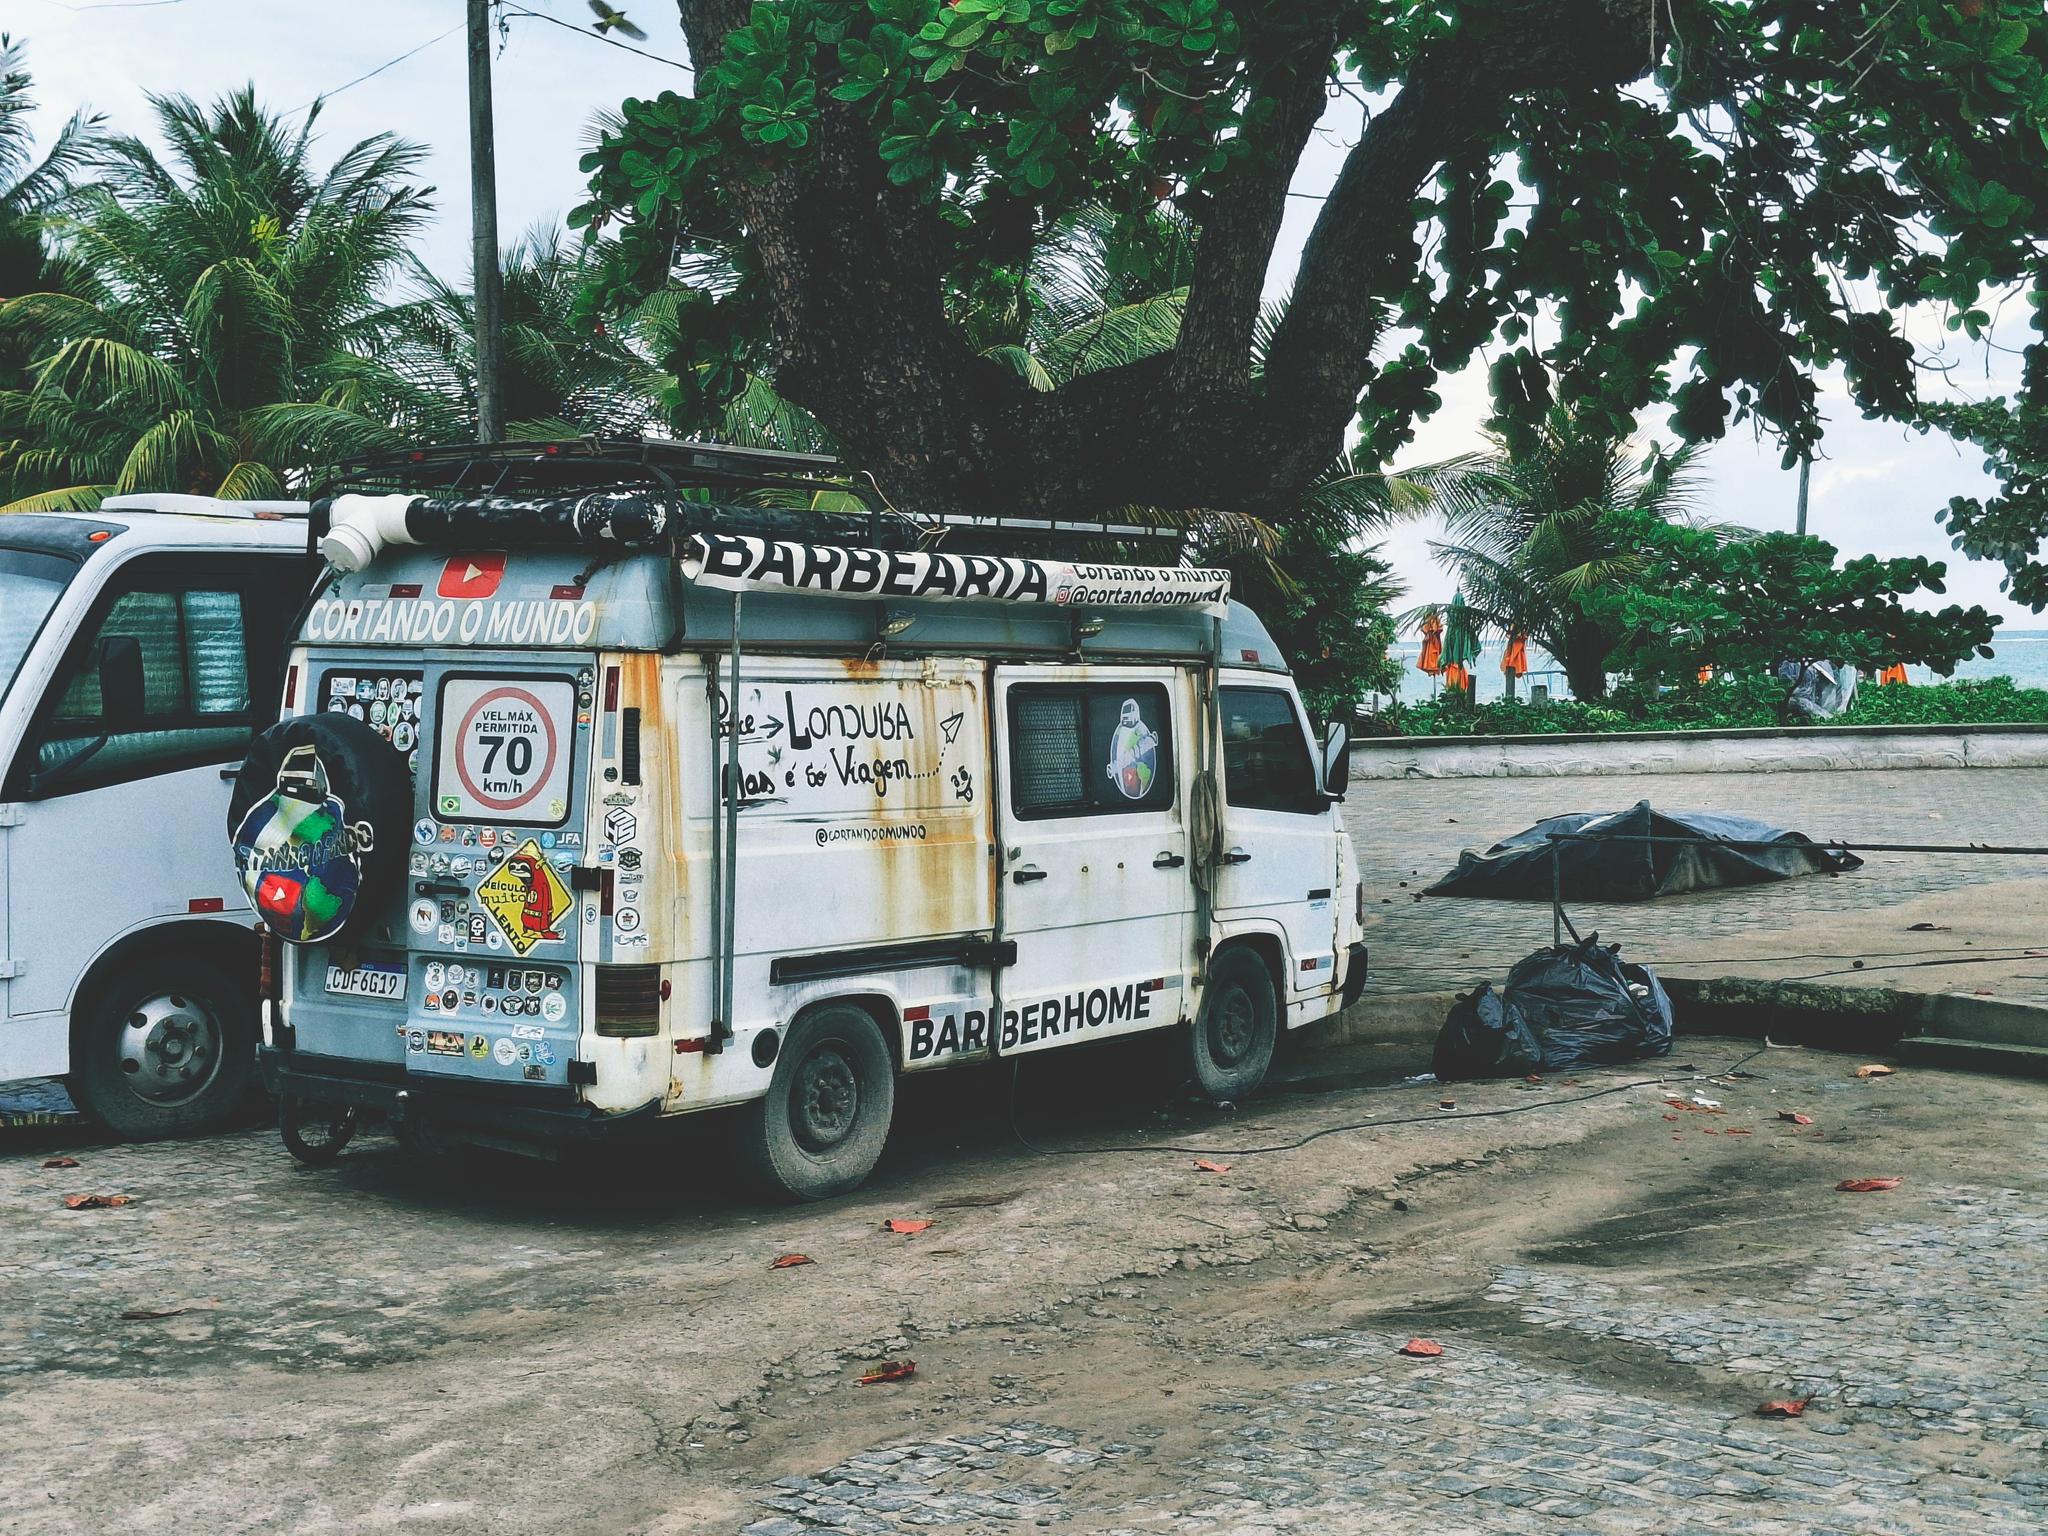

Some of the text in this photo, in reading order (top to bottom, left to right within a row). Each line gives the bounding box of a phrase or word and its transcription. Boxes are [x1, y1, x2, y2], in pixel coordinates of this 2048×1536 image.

[702, 532, 1048, 603] BARBEARIA
[306, 599, 597, 645] CORTANDO O MUNDO
[475, 722, 539, 735] PERMITIDA
[478, 735, 533, 777] 70
[483, 778, 523, 794] km/h
[785, 762, 797, 788] é
[556, 832, 581, 845] JFA
[816, 825, 926, 847] @CORTANDOOMUNDO
[484, 879, 527, 893] VEÍCULO
[481, 890, 528, 905] muito
[492, 906, 526, 952] LENTO
